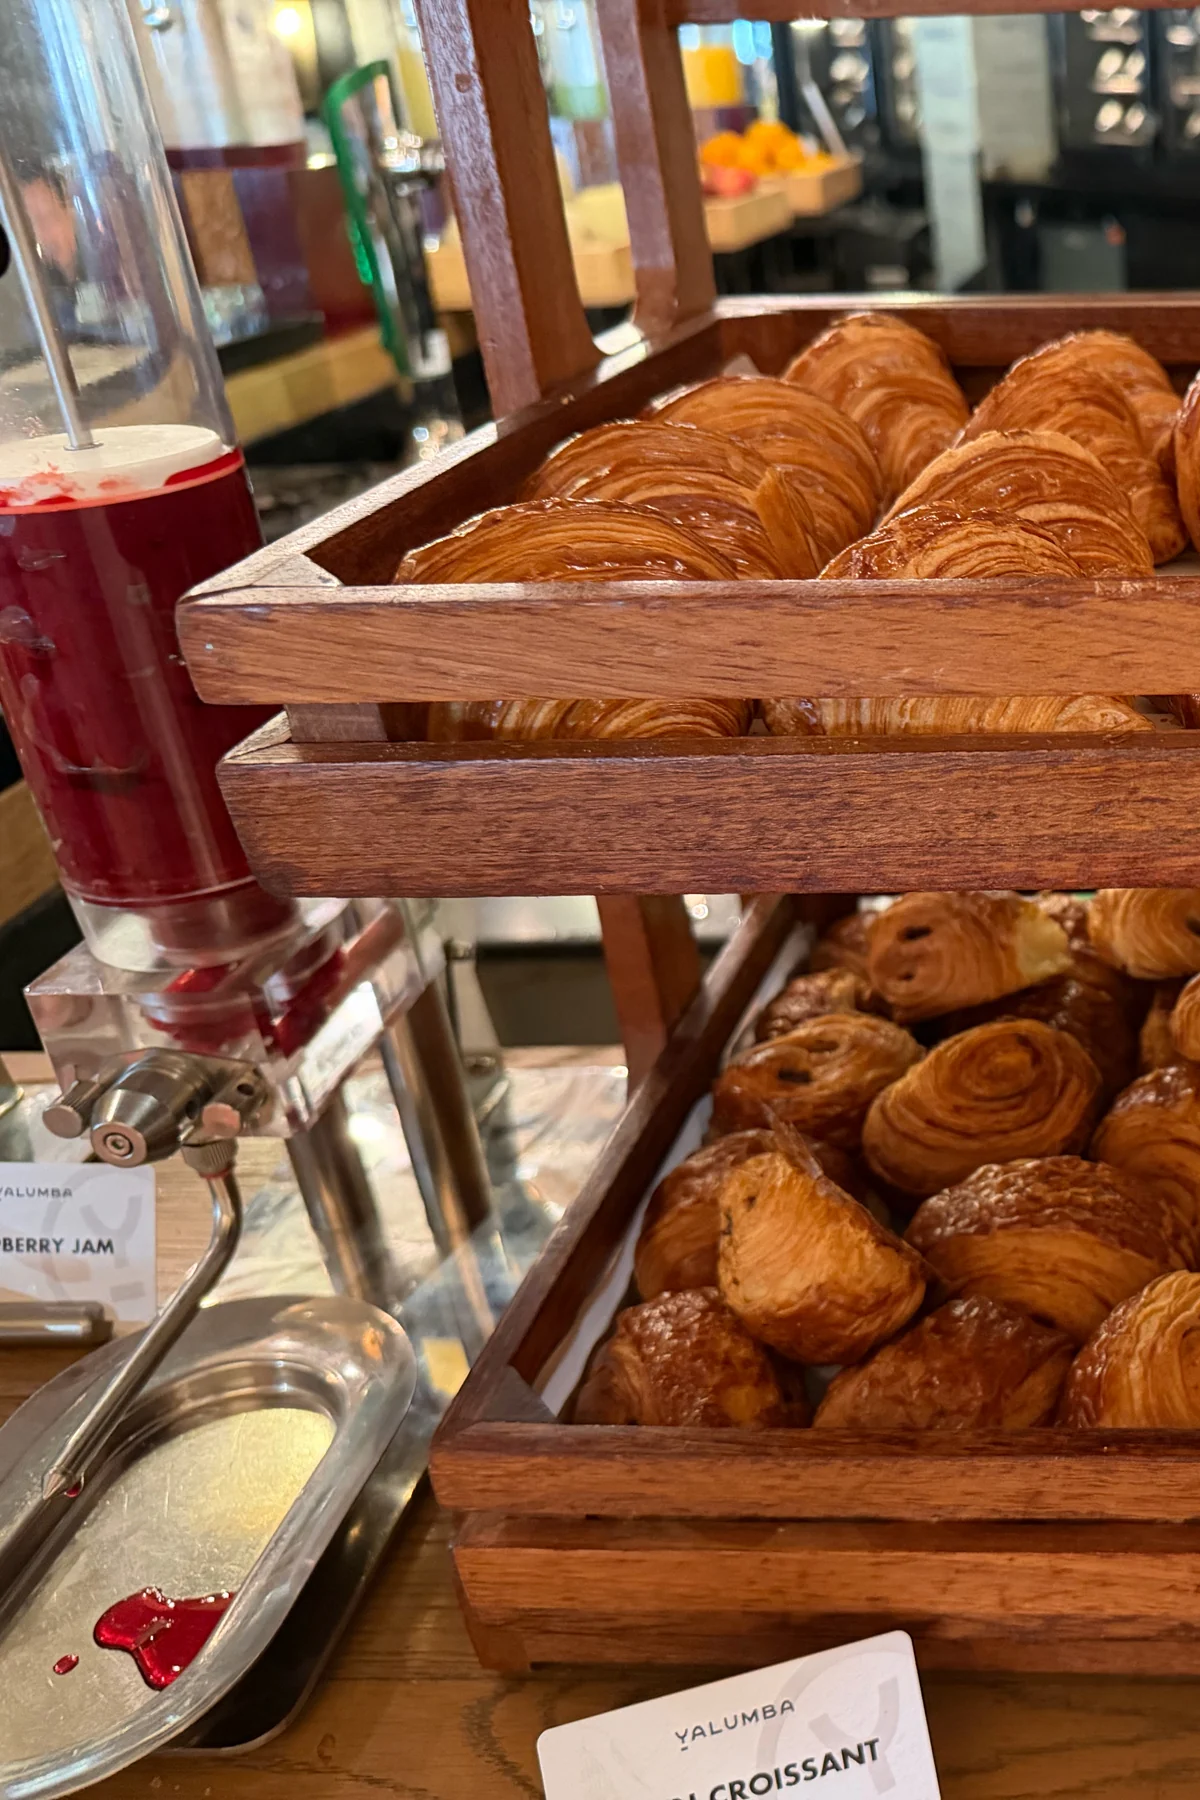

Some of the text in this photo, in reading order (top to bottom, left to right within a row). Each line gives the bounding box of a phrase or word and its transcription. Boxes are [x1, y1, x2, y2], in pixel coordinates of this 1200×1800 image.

[0, 1237, 114, 1254] BERRY JAM
[674, 1699, 795, 1751] YALUMBA
[709, 1738, 879, 1800] CROISSANT
